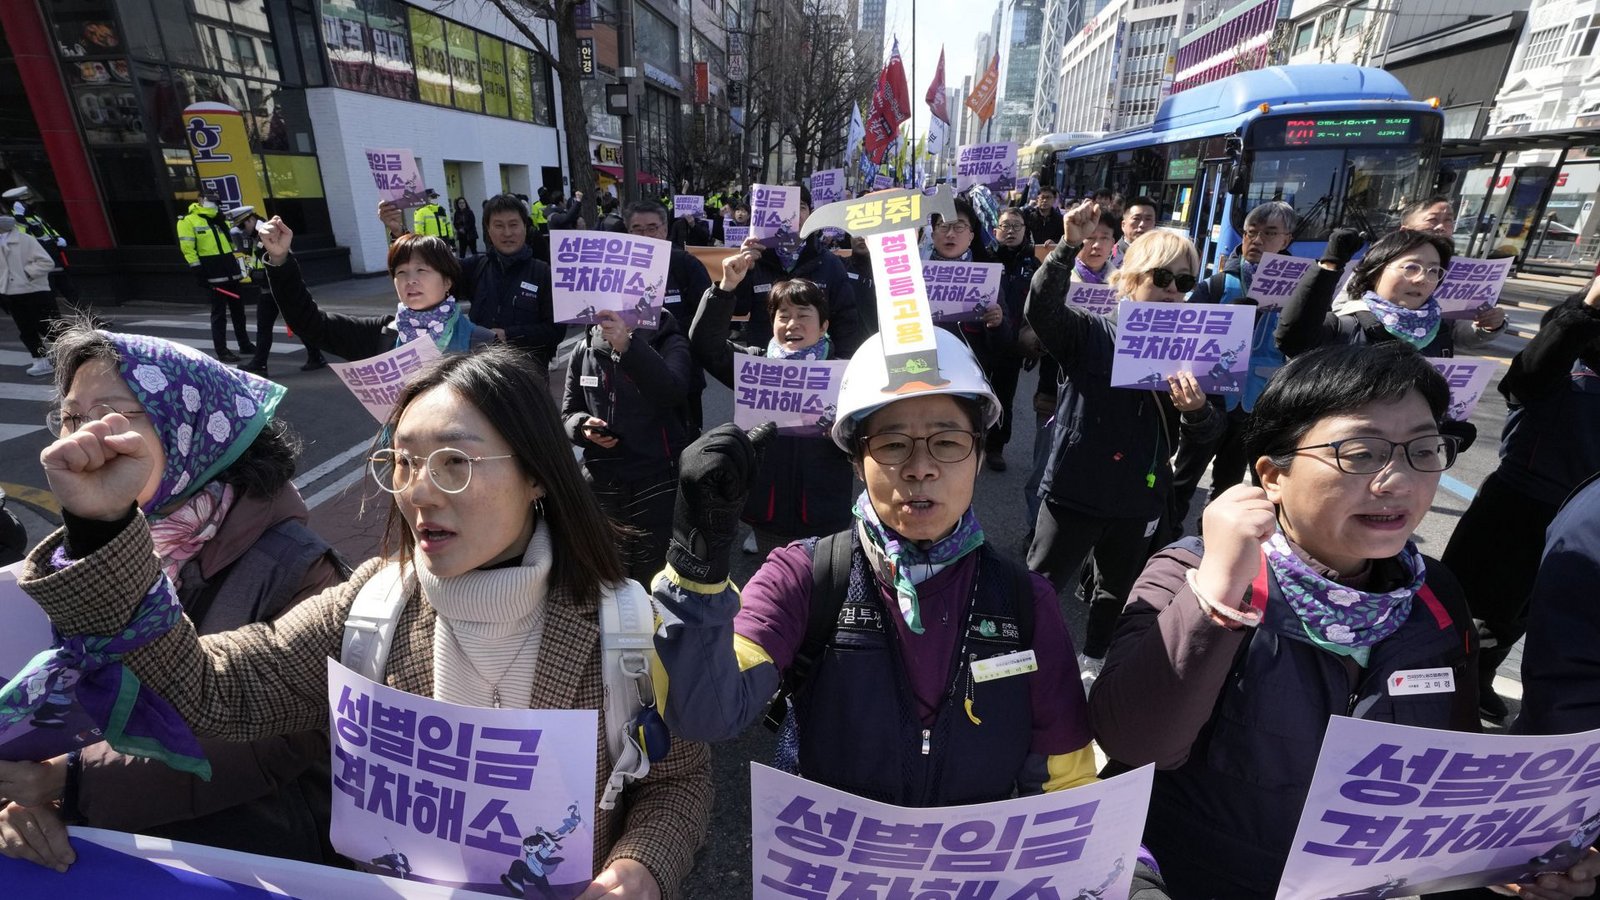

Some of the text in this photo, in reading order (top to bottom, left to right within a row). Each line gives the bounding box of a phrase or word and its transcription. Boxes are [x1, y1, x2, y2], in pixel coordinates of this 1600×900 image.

[581, 47, 593, 73] 안경
[960, 145, 1008, 162] 성별임금
[372, 173, 405, 190] 해소
[958, 161, 1003, 176] 격차해소
[753, 189, 787, 208] 임금
[845, 194, 921, 231] 쟁취
[558, 237, 655, 270] 성별임금
[554, 266, 646, 296] 격차해소
[922, 265, 989, 284] 성별임금
[1263, 259, 1308, 280] 성별
[1445, 262, 1507, 283] 별임금
[1072, 287, 1119, 305] 성별
[1252, 277, 1298, 296] 격차
[1434, 282, 1494, 301] 차해소
[1125, 307, 1235, 336] 성별임금
[1117, 335, 1222, 363] 격차해소
[342, 348, 423, 387] 성별임금
[740, 361, 832, 391] 성별임금
[1434, 364, 1479, 388] 임금
[354, 382, 405, 406] 격차해
[736, 386, 824, 416] 격차해소
[335, 684, 543, 792] 성별임금
[333, 744, 523, 858] 격차해소
[774, 795, 1101, 872] 성별임금
[1302, 796, 1591, 866] 격차해소
